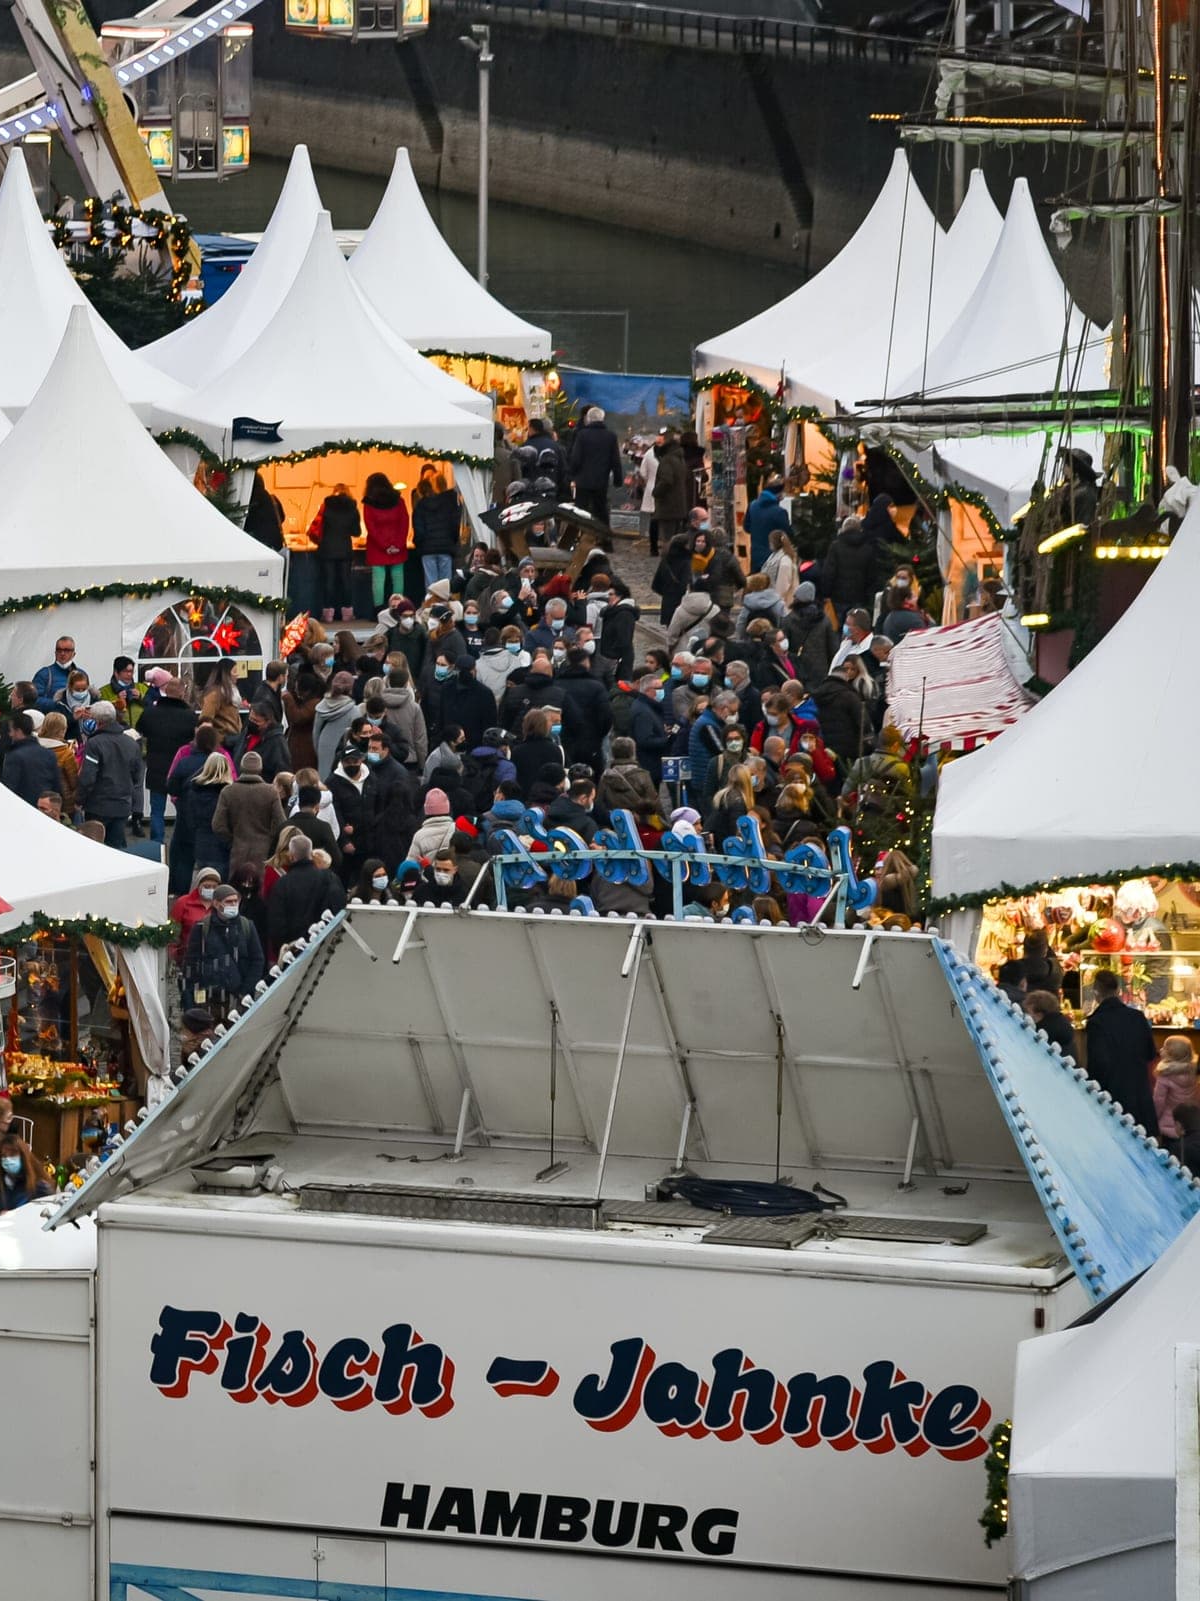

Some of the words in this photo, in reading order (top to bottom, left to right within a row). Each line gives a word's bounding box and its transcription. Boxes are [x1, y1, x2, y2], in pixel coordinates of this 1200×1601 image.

[149, 1304, 456, 1419] Fisch
[572, 1336, 993, 1462] Jahnke
[379, 1481, 740, 1556] HAMBURG
